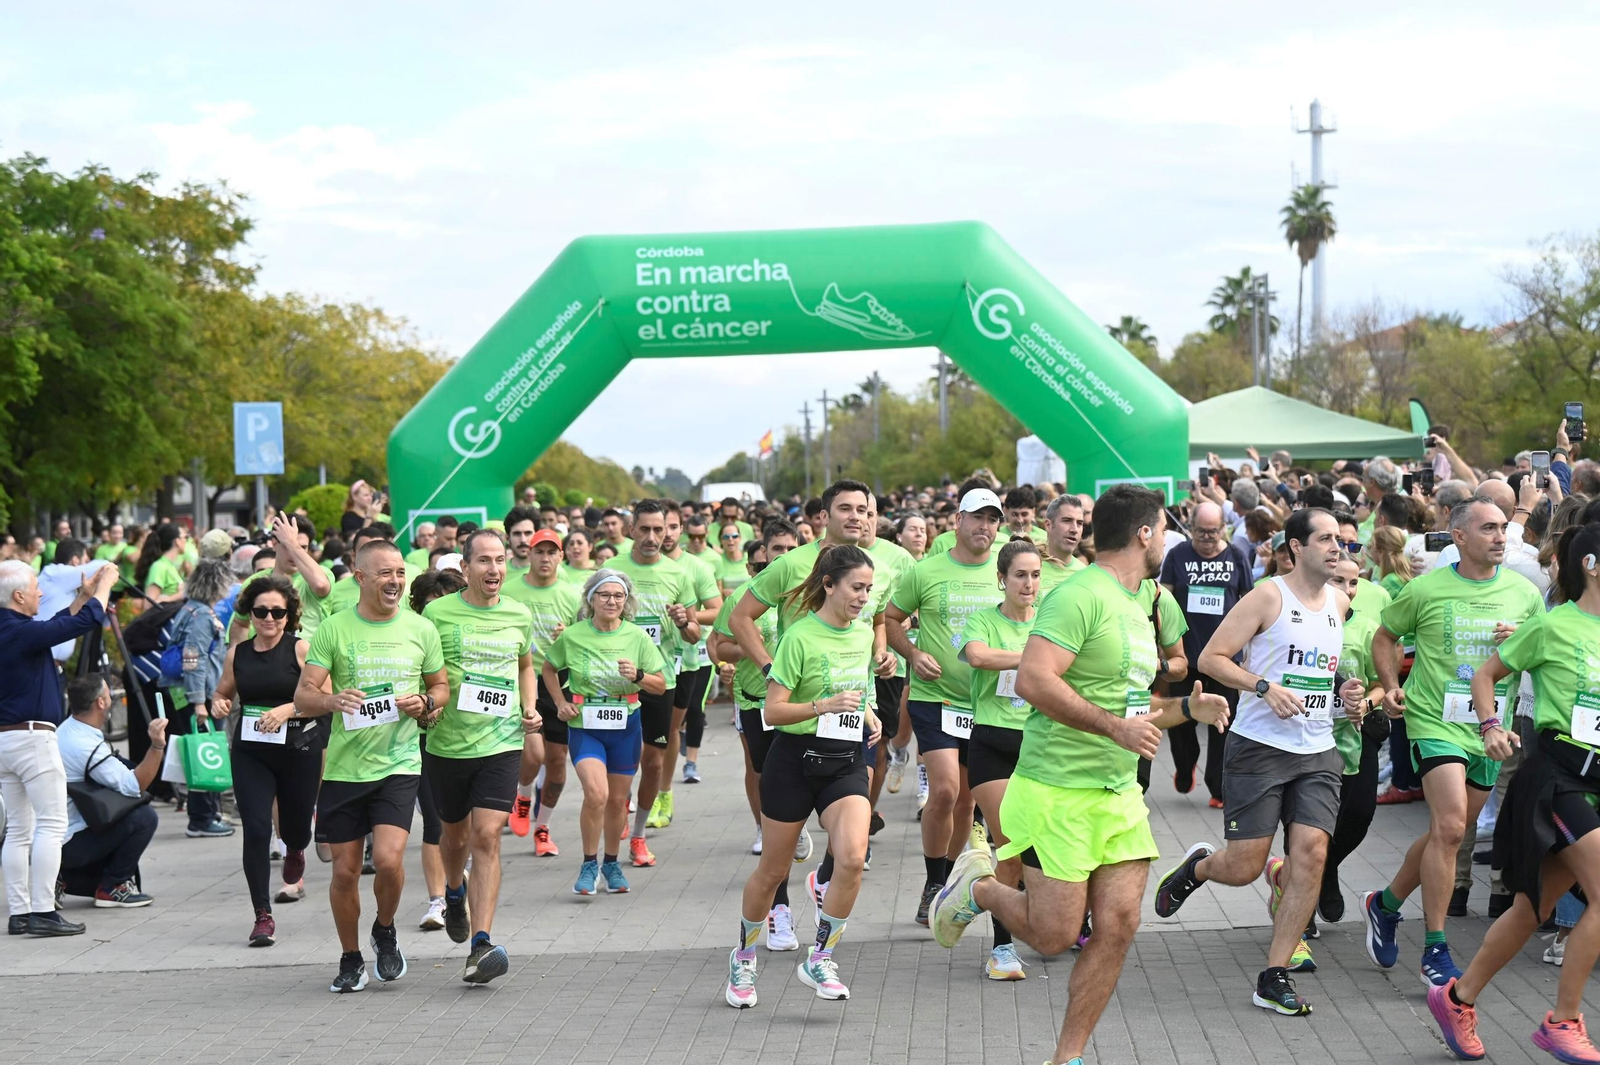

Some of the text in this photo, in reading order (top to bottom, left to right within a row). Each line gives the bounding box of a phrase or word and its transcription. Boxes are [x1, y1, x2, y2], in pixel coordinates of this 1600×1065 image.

[636, 246, 704, 258] Córdoba
[636, 258, 789, 286] En marcha
[636, 289, 731, 315] contra
[638, 317, 772, 340] el cáncer
[484, 300, 582, 403] asociación española
[1009, 345, 1026, 361] en
[1020, 333, 1104, 407] contra el cáncer
[1030, 322, 1134, 415] asociación española
[495, 377, 531, 413] contra
[528, 365, 541, 380] el
[507, 363, 566, 423] en Córdoba
[247, 412, 269, 441] P
[1185, 561, 1234, 572] VA POR TI
[1187, 572, 1231, 584] PABLO
[949, 593, 962, 602] En
[1200, 597, 1220, 607] 0301
[1443, 601, 1453, 655] CÓRDOBA
[1455, 616, 1469, 626] En
[462, 638, 476, 646] En
[1454, 630, 1494, 641] contr
[1455, 642, 1498, 656] cánc
[357, 655, 414, 667] En marcha
[1287, 644, 1338, 672] indea
[357, 667, 412, 678] contra el
[477, 690, 507, 706] 4683
[1304, 694, 1327, 709] 1278
[360, 699, 392, 717] 4684
[597, 710, 623, 721] 4896
[838, 714, 861, 729] 1462
[956, 716, 975, 730] 038
